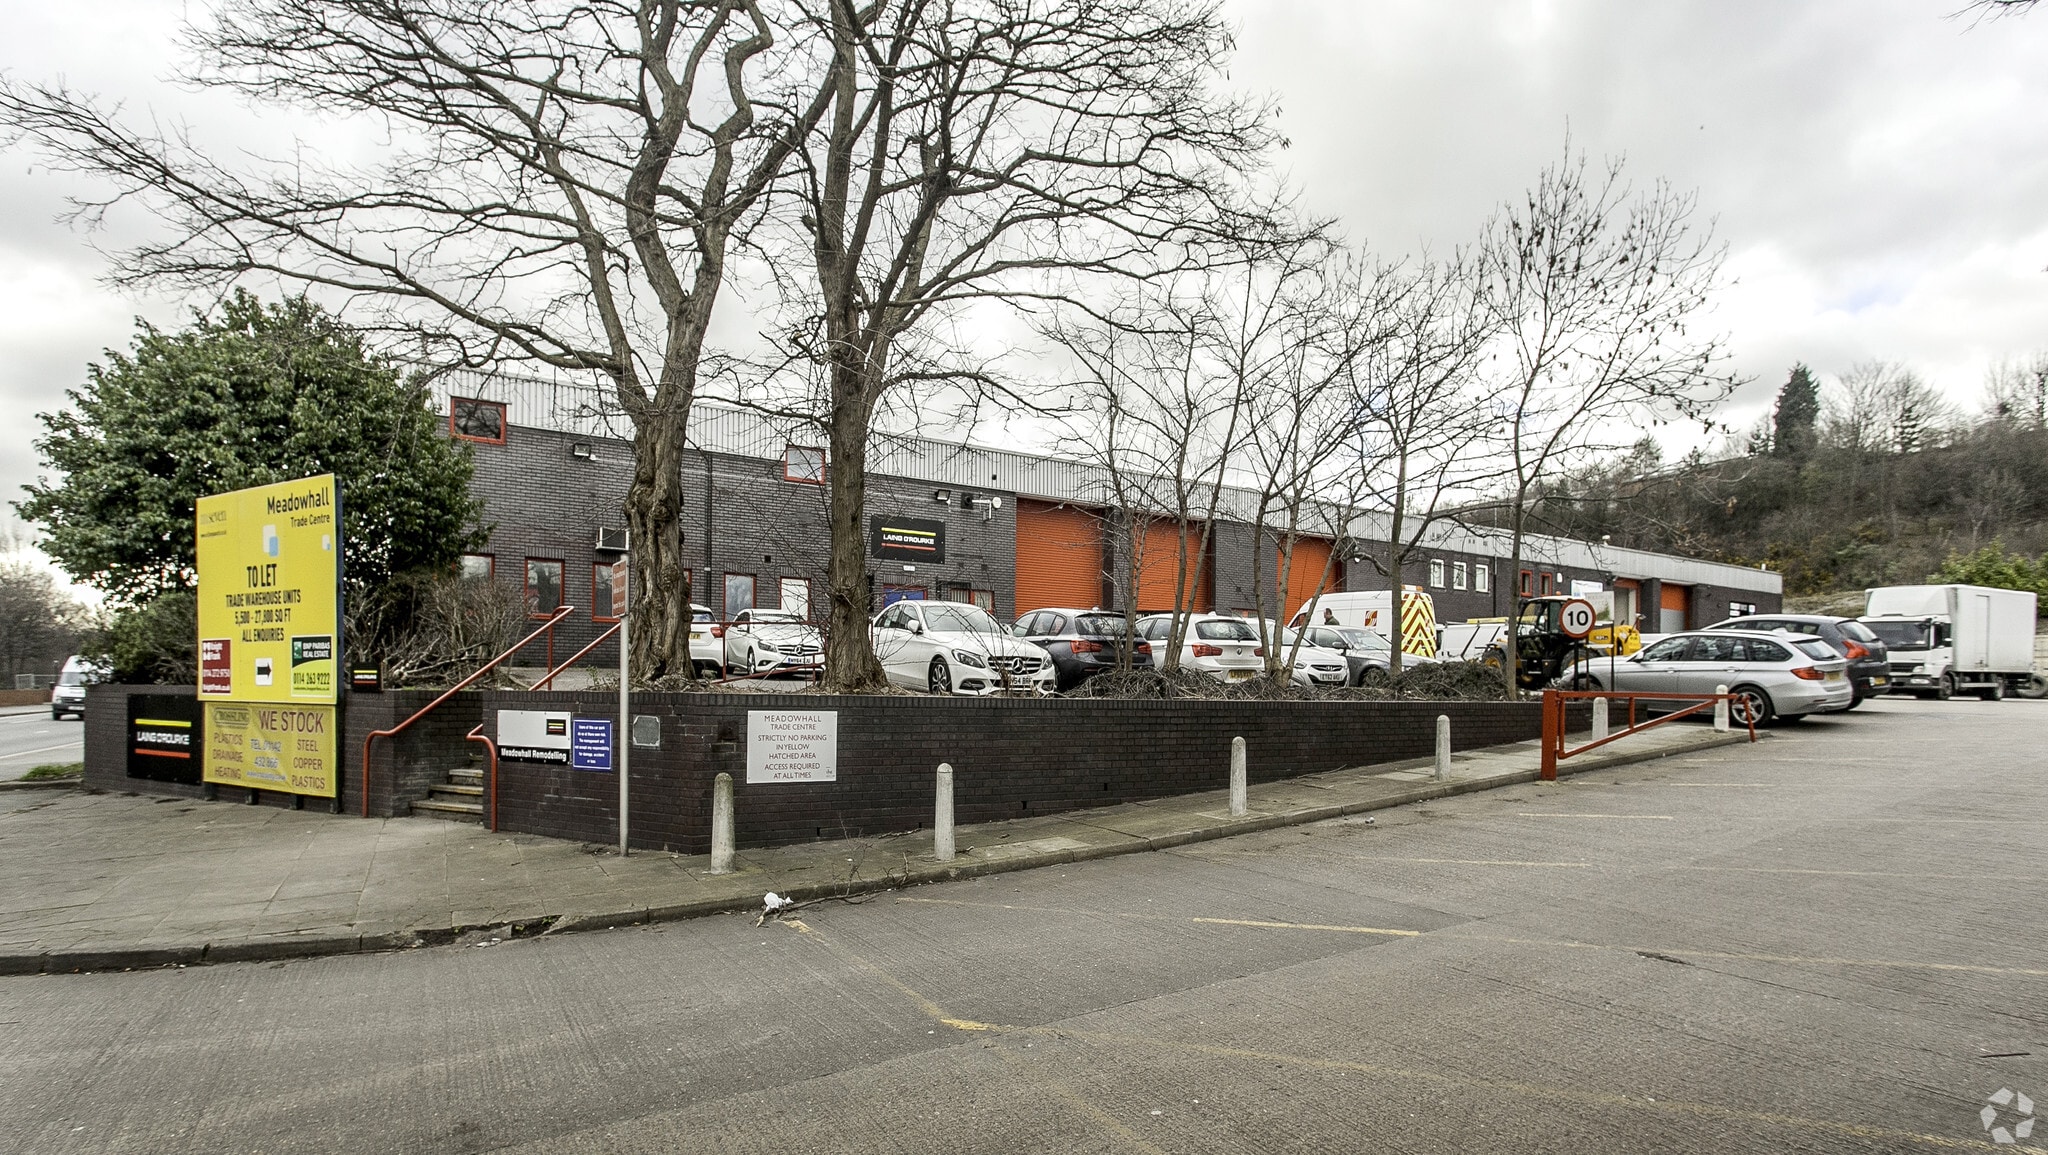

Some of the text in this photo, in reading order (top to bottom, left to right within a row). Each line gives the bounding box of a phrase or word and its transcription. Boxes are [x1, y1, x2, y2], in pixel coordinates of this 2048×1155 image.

[267, 487, 330, 515] Meadowhall
[290, 513, 331, 528] Trade Centre
[883, 534, 902, 542] LAING
[246, 563, 277, 588] TO LET
[226, 589, 301, 608] TRADE WAREHOUSE UNITS
[275, 608, 283, 623] SQ
[284, 607, 291, 623] FT
[1568, 610, 1588, 626] 10
[242, 627, 285, 643] ALL ENQUIRIES
[303, 641, 330, 650] BNP PARIBAS
[303, 650, 329, 658] REAL ESTATE
[294, 672, 330, 685] 0114 263 9222
[259, 710, 324, 734] WE STOCK
[214, 732, 243, 746] PLASTICS
[297, 738, 319, 752] STEEL
[758, 734, 787, 742] STRICTLY
[788, 734, 799, 742] NO
[212, 748, 244, 763] DRAINAGE
[501, 747, 567, 763] Meadowhall Remodelling
[293, 757, 323, 770] COPPER
[789, 762, 820, 770] REQUIRED
[215, 765, 241, 780] HEATING
[292, 774, 326, 790] PLASTICS
